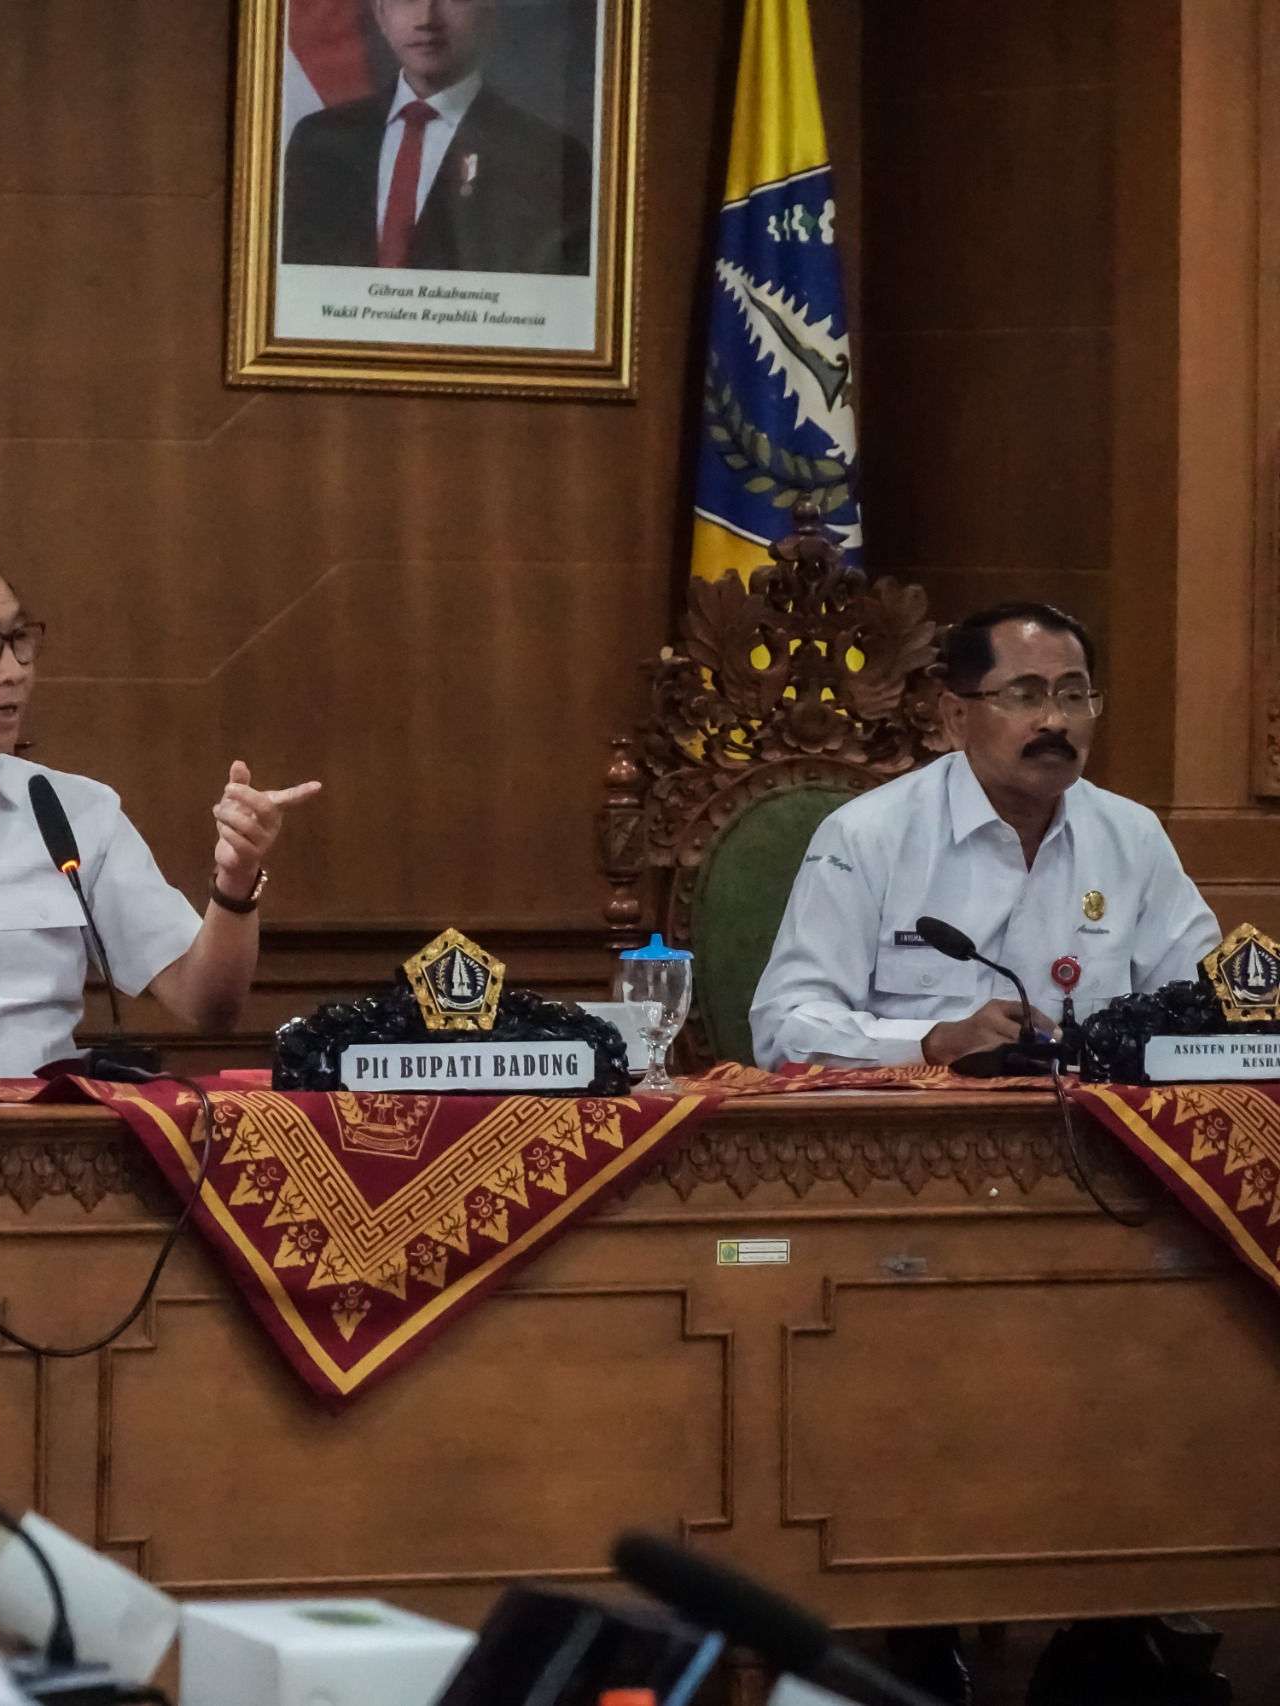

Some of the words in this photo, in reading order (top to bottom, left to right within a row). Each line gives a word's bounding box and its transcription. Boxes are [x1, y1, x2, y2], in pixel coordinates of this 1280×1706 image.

[368, 283, 414, 298] Gibran
[417, 285, 501, 302] Rakabuming
[321, 305, 358, 319] Wakil
[362, 306, 418, 321] Presiden
[421, 308, 477, 324] Republik
[483, 311, 546, 326] Indonesia
[1174, 1044, 1225, 1055] ASISTEN
[1230, 1043, 1280, 1054] PEMERI
[355, 1056, 389, 1079] Plt
[399, 1055, 482, 1078] BUPATI
[492, 1053, 579, 1076] BADUNG
